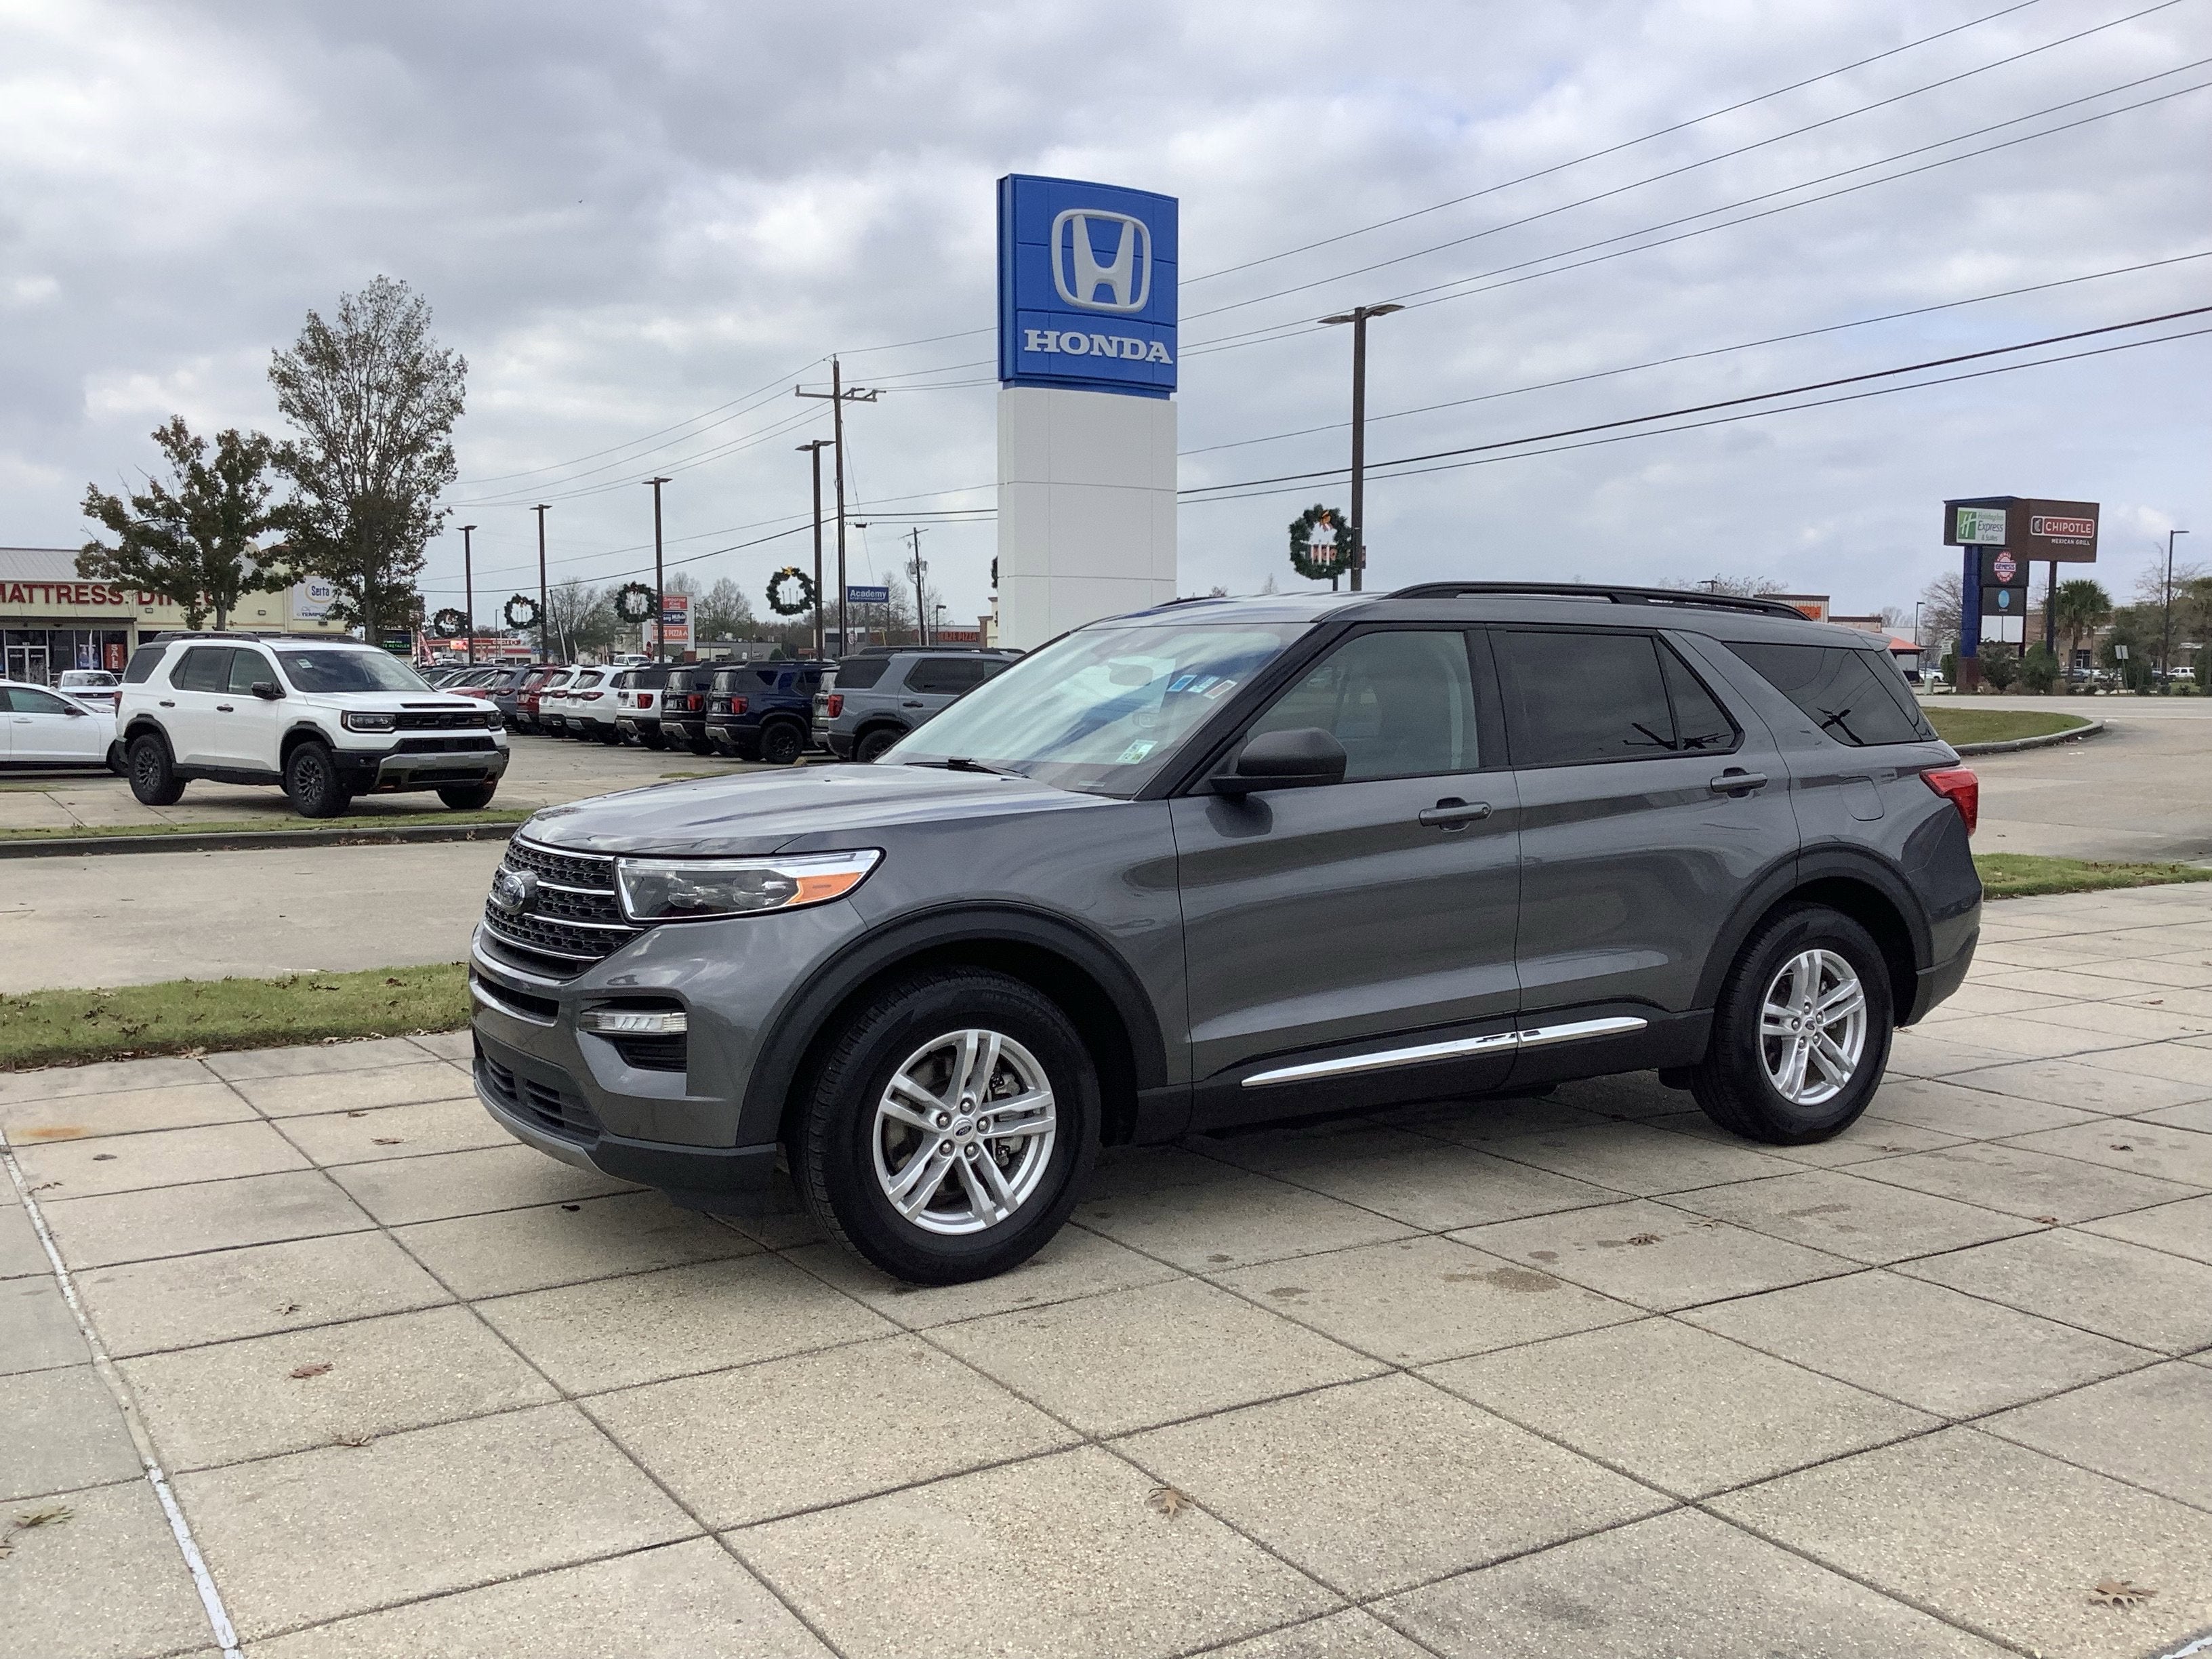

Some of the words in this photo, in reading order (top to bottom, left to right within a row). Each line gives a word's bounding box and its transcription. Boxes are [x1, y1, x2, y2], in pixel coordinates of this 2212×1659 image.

[1023, 329, 1173, 365] HONDA
[1978, 520, 2004, 533] Express
[2045, 521, 2091, 533] CHIPOTLE
[311, 586, 330, 596] Serta
[849, 589, 886, 600] Academy
[110, 644, 119, 669] SALE
